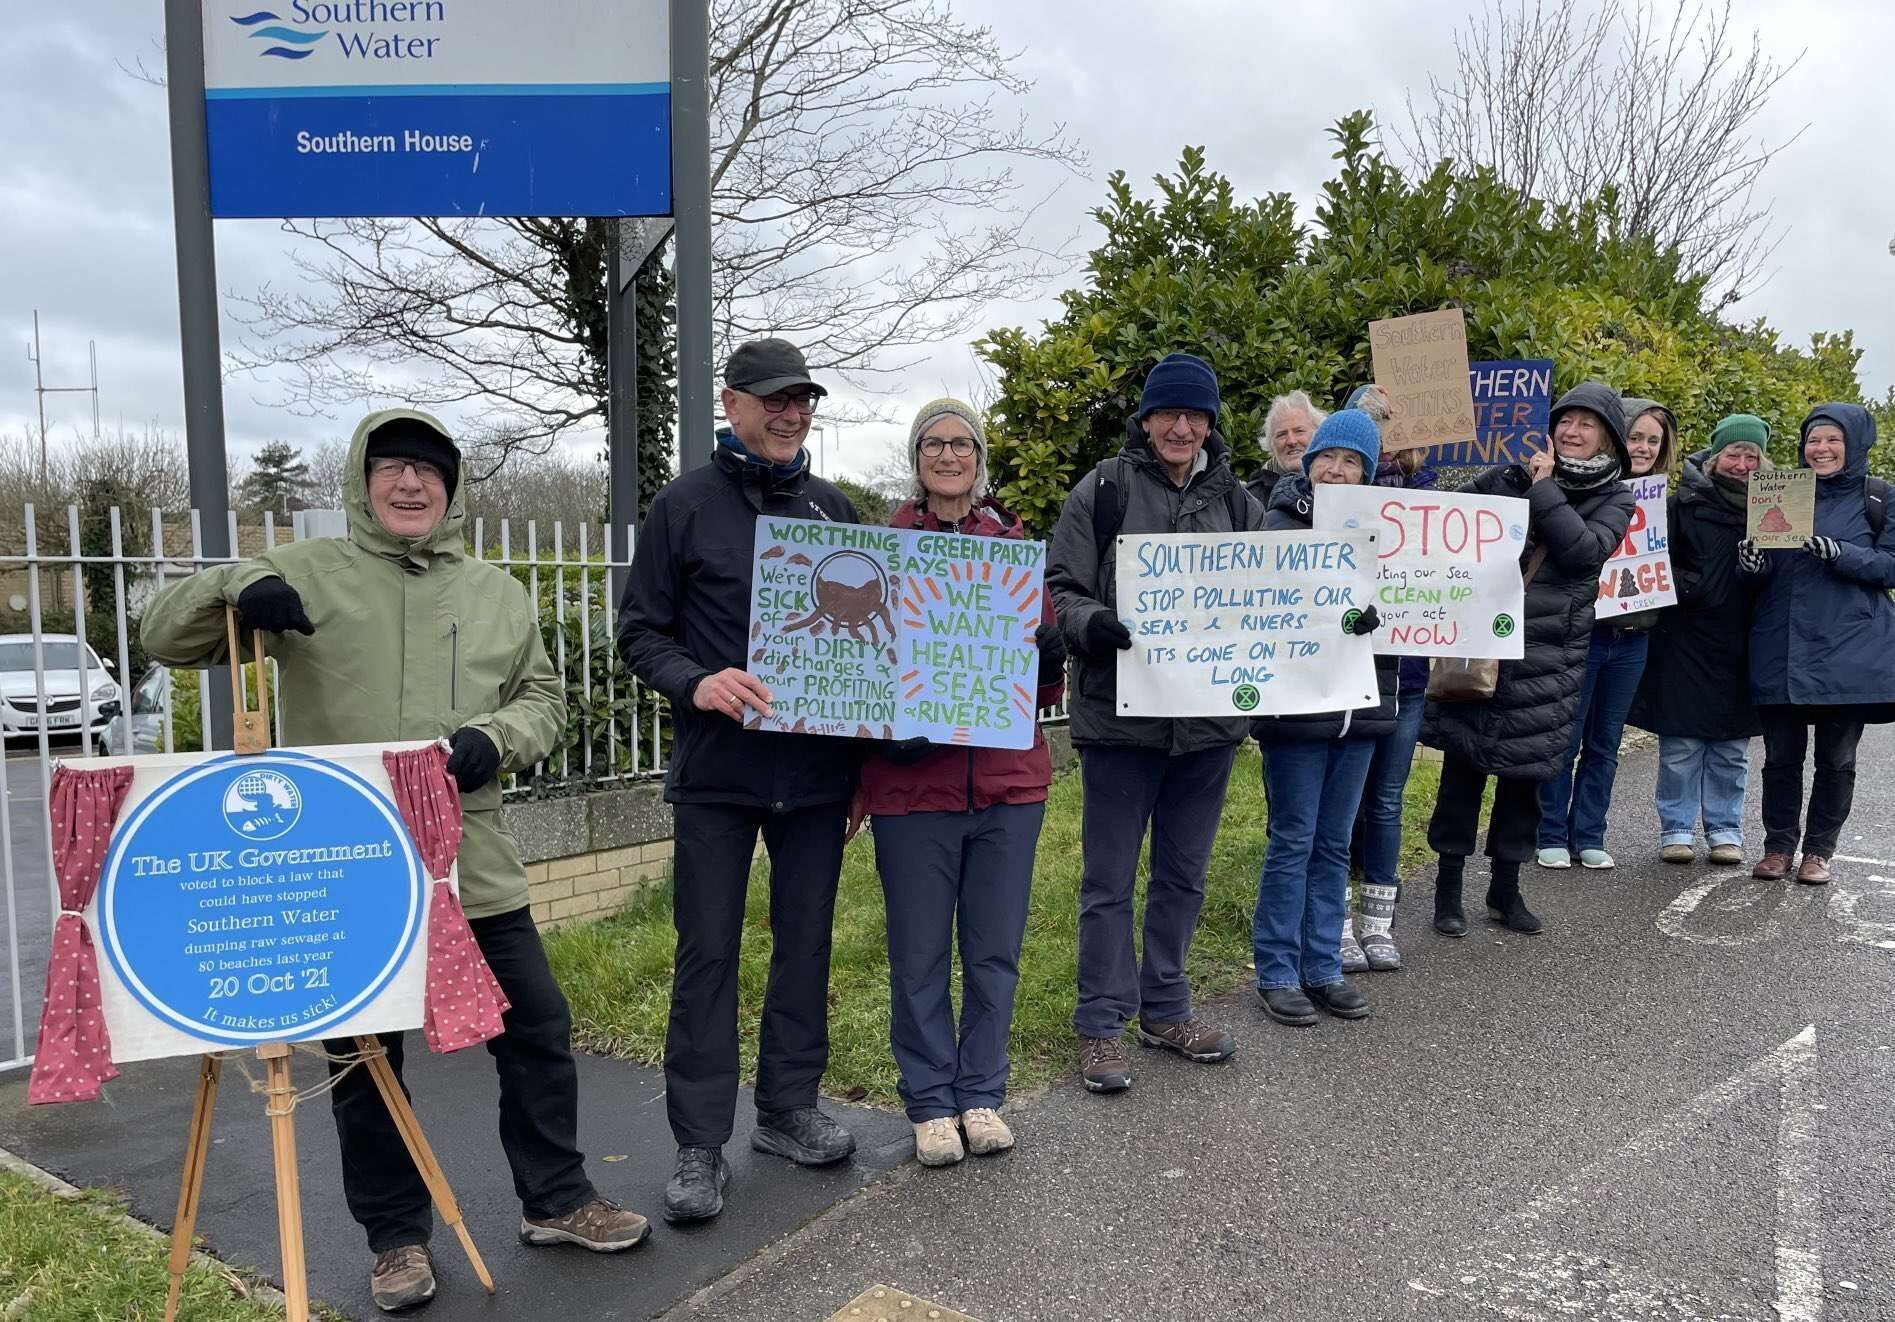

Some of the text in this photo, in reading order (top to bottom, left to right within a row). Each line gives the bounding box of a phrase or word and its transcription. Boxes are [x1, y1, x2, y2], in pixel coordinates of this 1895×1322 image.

[292, 0, 444, 24] Southern
[336, 32, 440, 59] Water
[297, 130, 473, 154] Southern House
[1376, 320, 1463, 350] Southern
[1390, 354, 1456, 386] Water
[1474, 402, 1532, 428] TER
[1753, 472, 1807, 481] Southern
[1760, 482, 1786, 492] Water
[1751, 494, 1782, 504] Don't
[1377, 501, 1504, 563] STOP
[1647, 527, 1666, 551] the
[1761, 534, 1780, 542] our
[768, 522, 1042, 568] WORTHING GREEN PARTY
[887, 553, 948, 578] SAYS
[1137, 541, 1357, 578] SOUTHERN WATER
[760, 564, 807, 586] We're
[1414, 569, 1437, 578] our
[758, 587, 809, 611] SICK
[945, 582, 992, 612] WE
[1135, 585, 1356, 614] STOP POLLUTING OUR
[1380, 586, 1472, 604] CLEAN UP
[760, 609, 783, 628] of
[928, 610, 1019, 640] WANT
[1138, 619, 1188, 636] SEA'S
[1241, 613, 1308, 631] RIVERS
[1381, 606, 1446, 627] your act
[1391, 621, 1458, 645] NOW
[763, 633, 887, 660] your DIRTY
[912, 640, 1033, 675] HEALTHY
[1147, 640, 1320, 665] IT'S GONE ON TOO
[763, 649, 864, 678] discharges
[1211, 666, 1274, 685] LONG
[757, 674, 895, 700] your PROFITING
[932, 671, 1008, 704] SEAS
[794, 696, 895, 722] POLLUTION
[918, 700, 1012, 729] RIVERS
[132, 839, 392, 877] The UK Government
[180, 869, 344, 891] voted to block a law that
[200, 887, 327, 908] could have stopped
[187, 909, 339, 934] Southern Water
[185, 930, 346, 955] dumping raw sewage at
[219, 957, 273, 970] beaches
[277, 953, 300, 965] last
[304, 951, 334, 963] year
[208, 966, 330, 999] 20 Oct '21
[202, 993, 338, 1030] It makes us sick!
